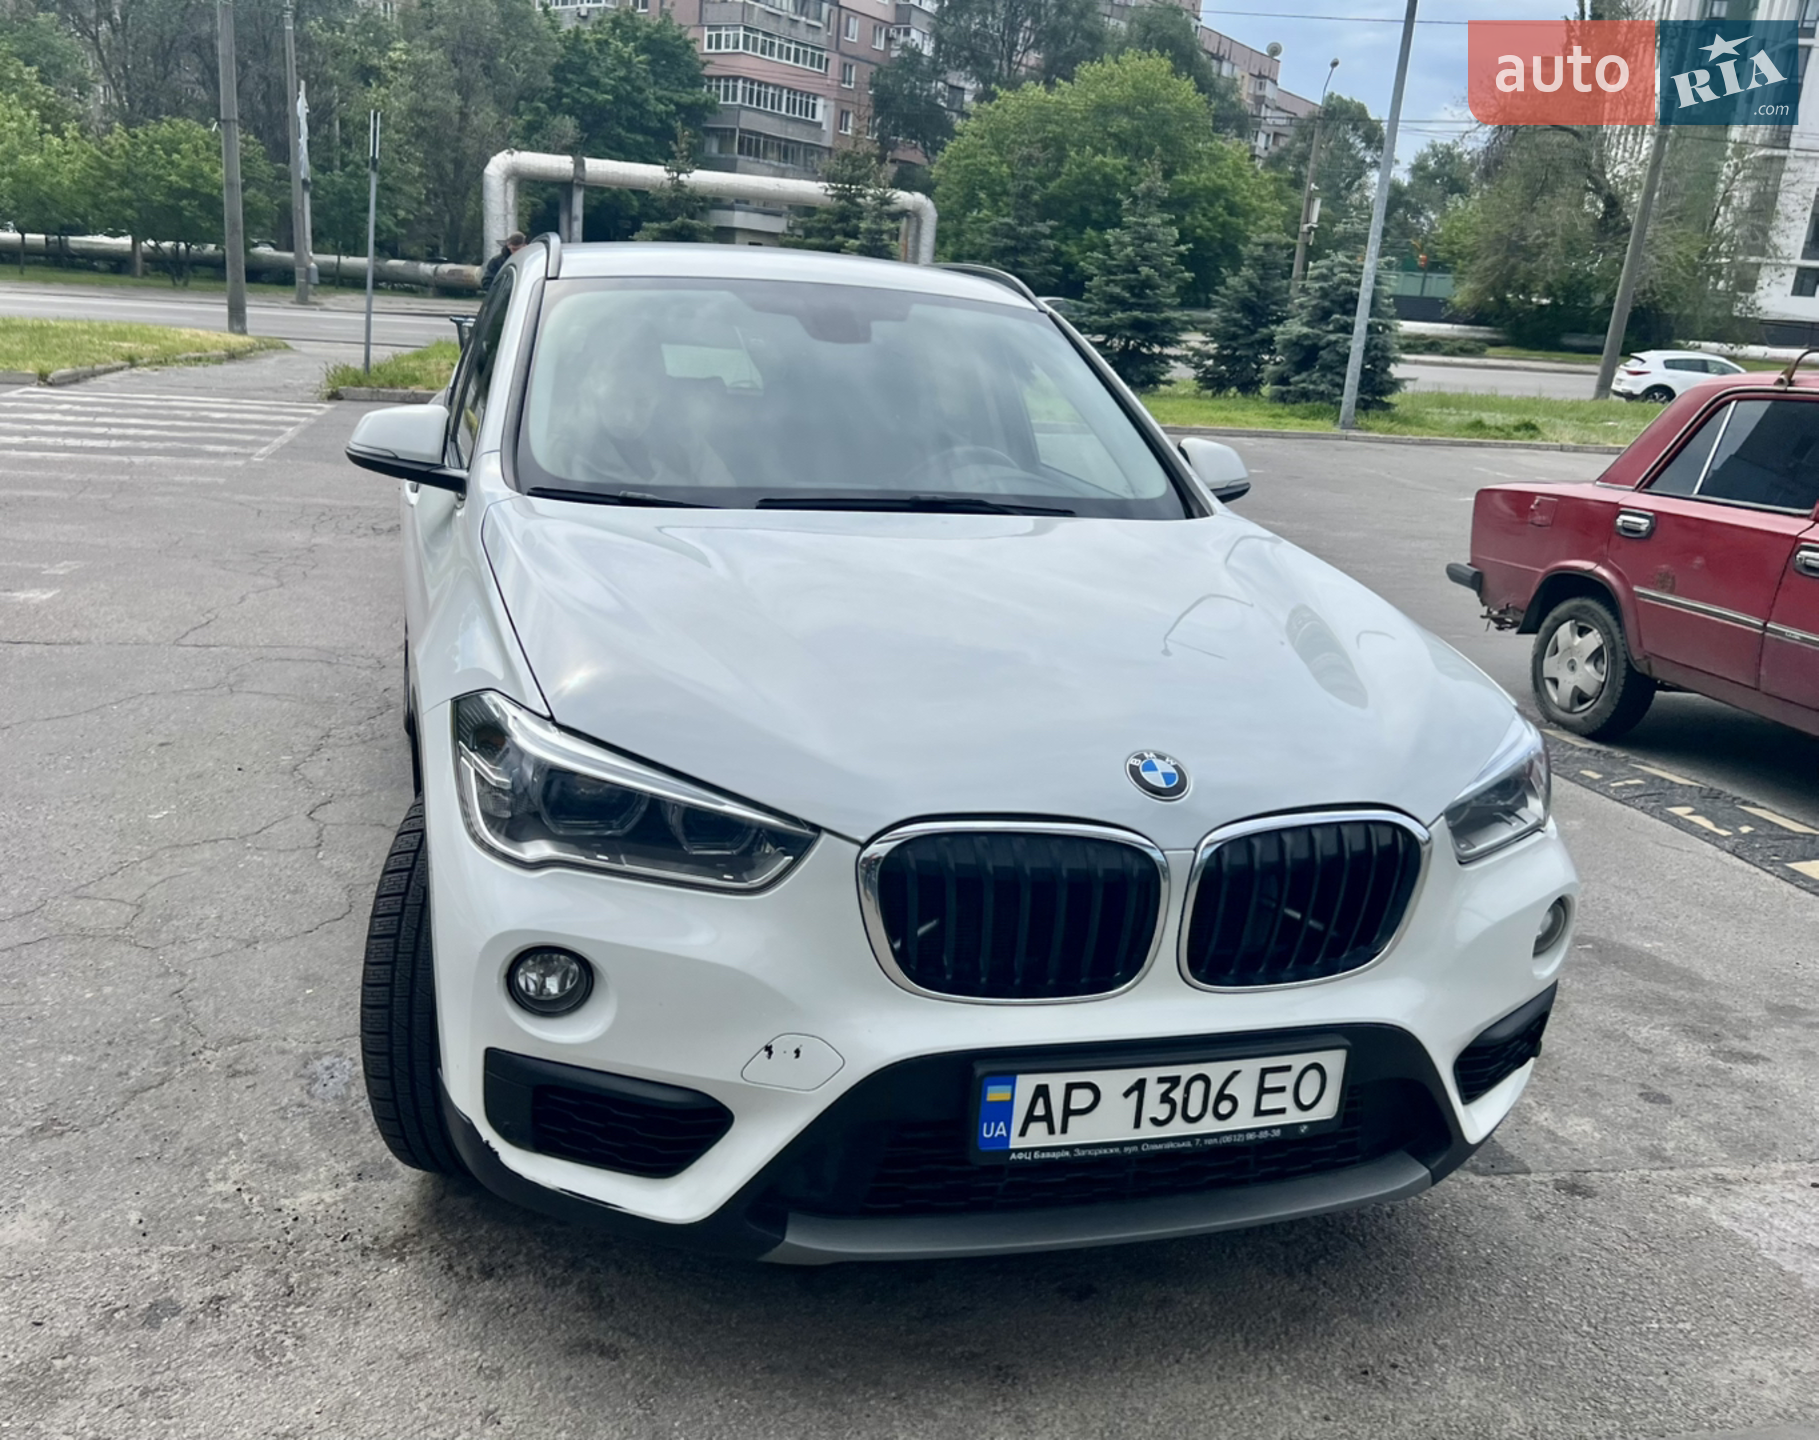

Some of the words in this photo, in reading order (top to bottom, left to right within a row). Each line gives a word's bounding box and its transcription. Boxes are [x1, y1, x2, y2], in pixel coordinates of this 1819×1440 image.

[1018, 1081, 1102, 1137] AP
[1122, 1069, 1242, 1130] 1306
[1253, 1062, 1327, 1118] EO
[983, 1121, 1007, 1139] UA
